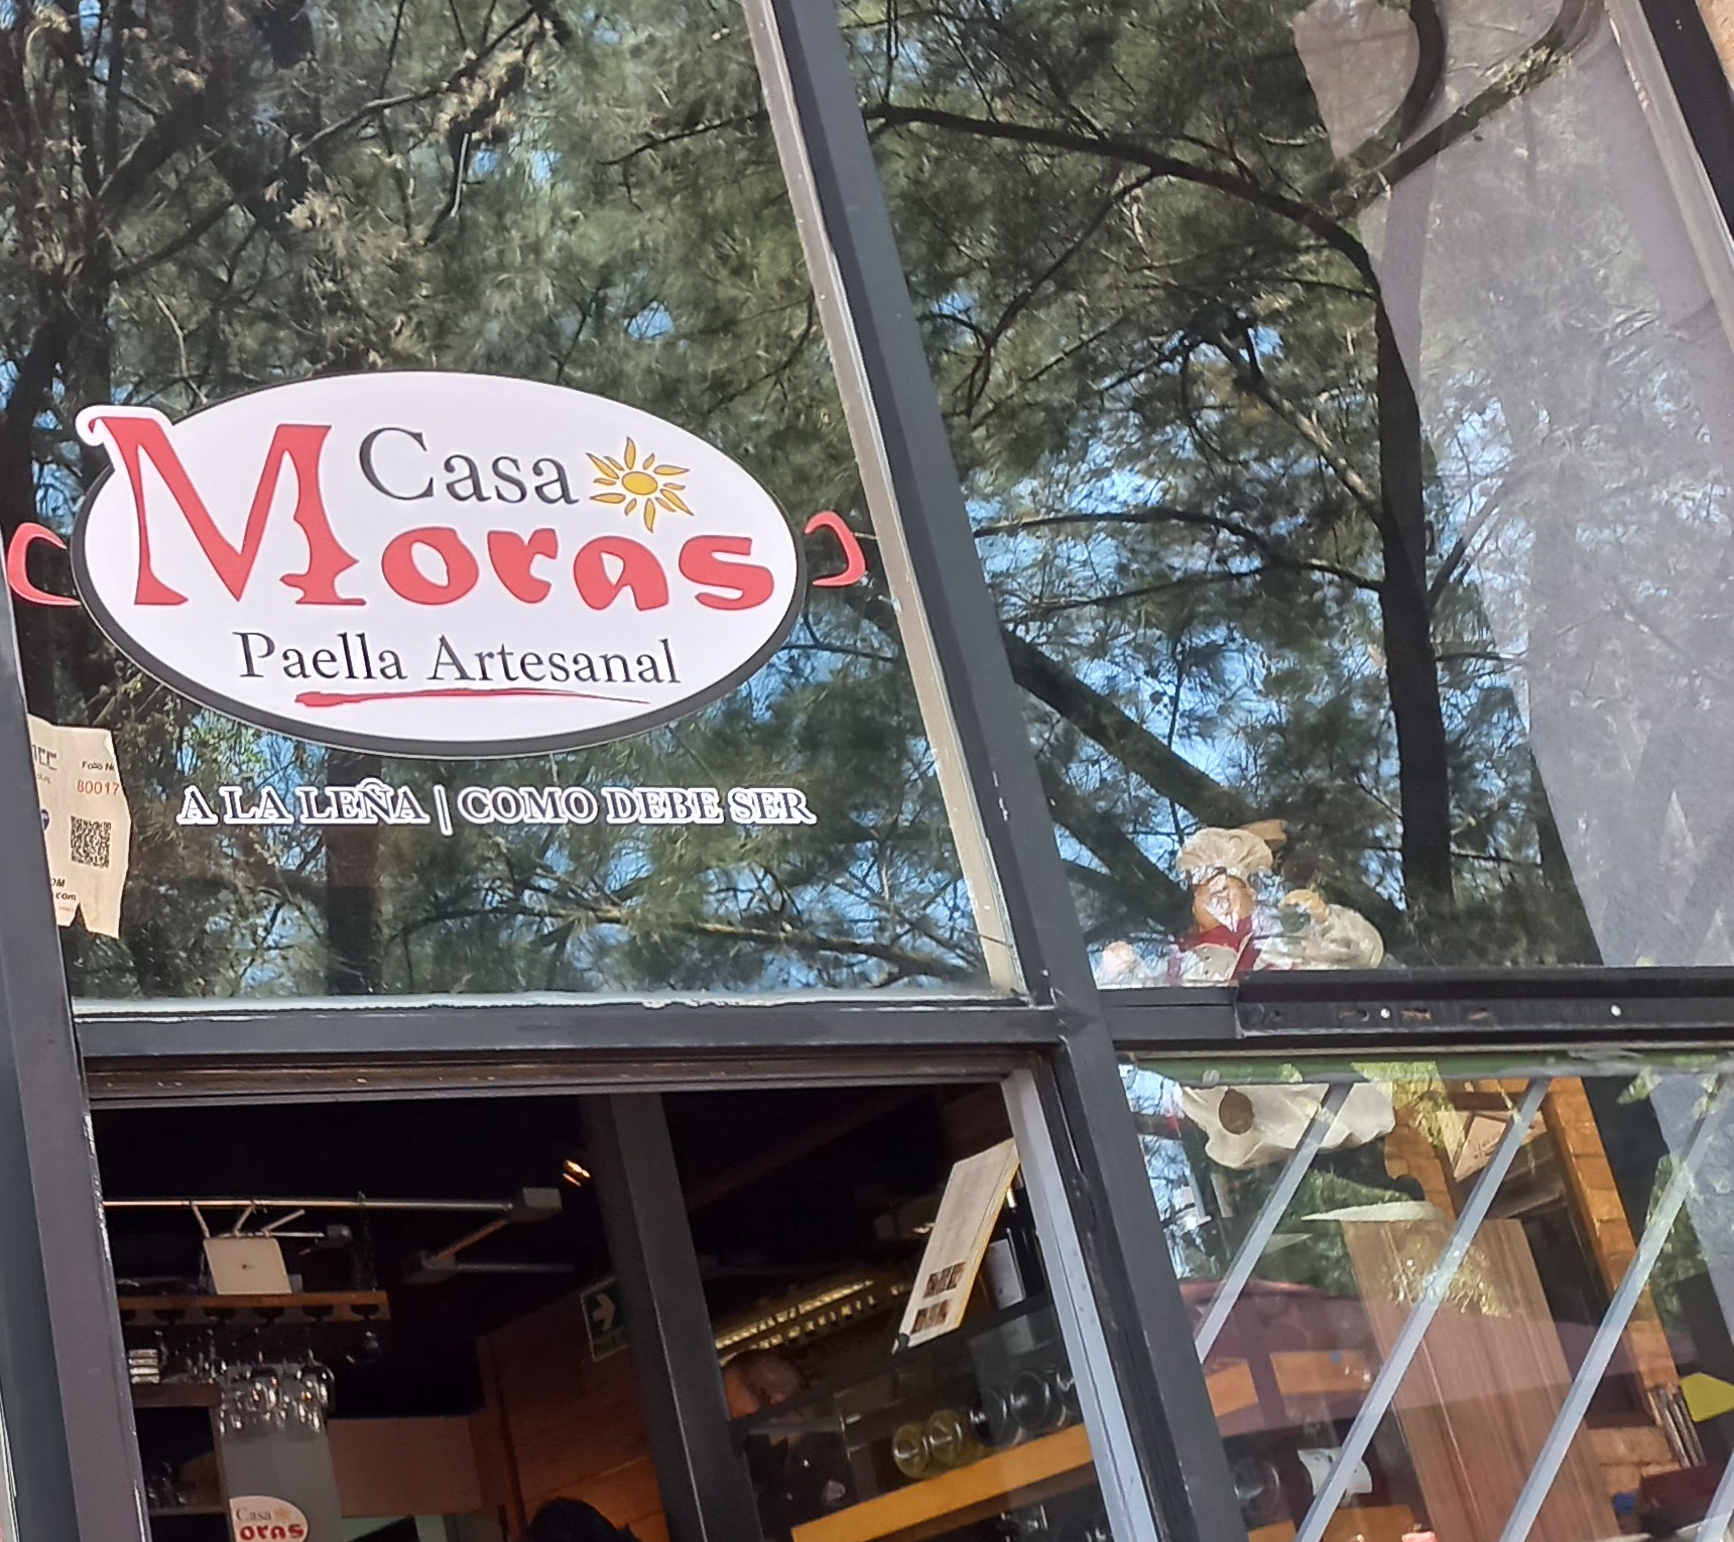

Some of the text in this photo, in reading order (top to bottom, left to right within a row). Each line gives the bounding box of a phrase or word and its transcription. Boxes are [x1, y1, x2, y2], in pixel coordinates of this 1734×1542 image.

[359, 427, 580, 506] Casa
[87, 416, 775, 611] Moras
[232, 631, 683, 686] Paella Artesanal
[176, 786, 217, 825] A
[221, 786, 293, 825] LA
[298, 776, 430, 825] LEÑA
[457, 787, 599, 825] COMO
[601, 787, 724, 825] DEBE
[728, 787, 817, 825] SER
[239, 1524, 305, 1541] oras
